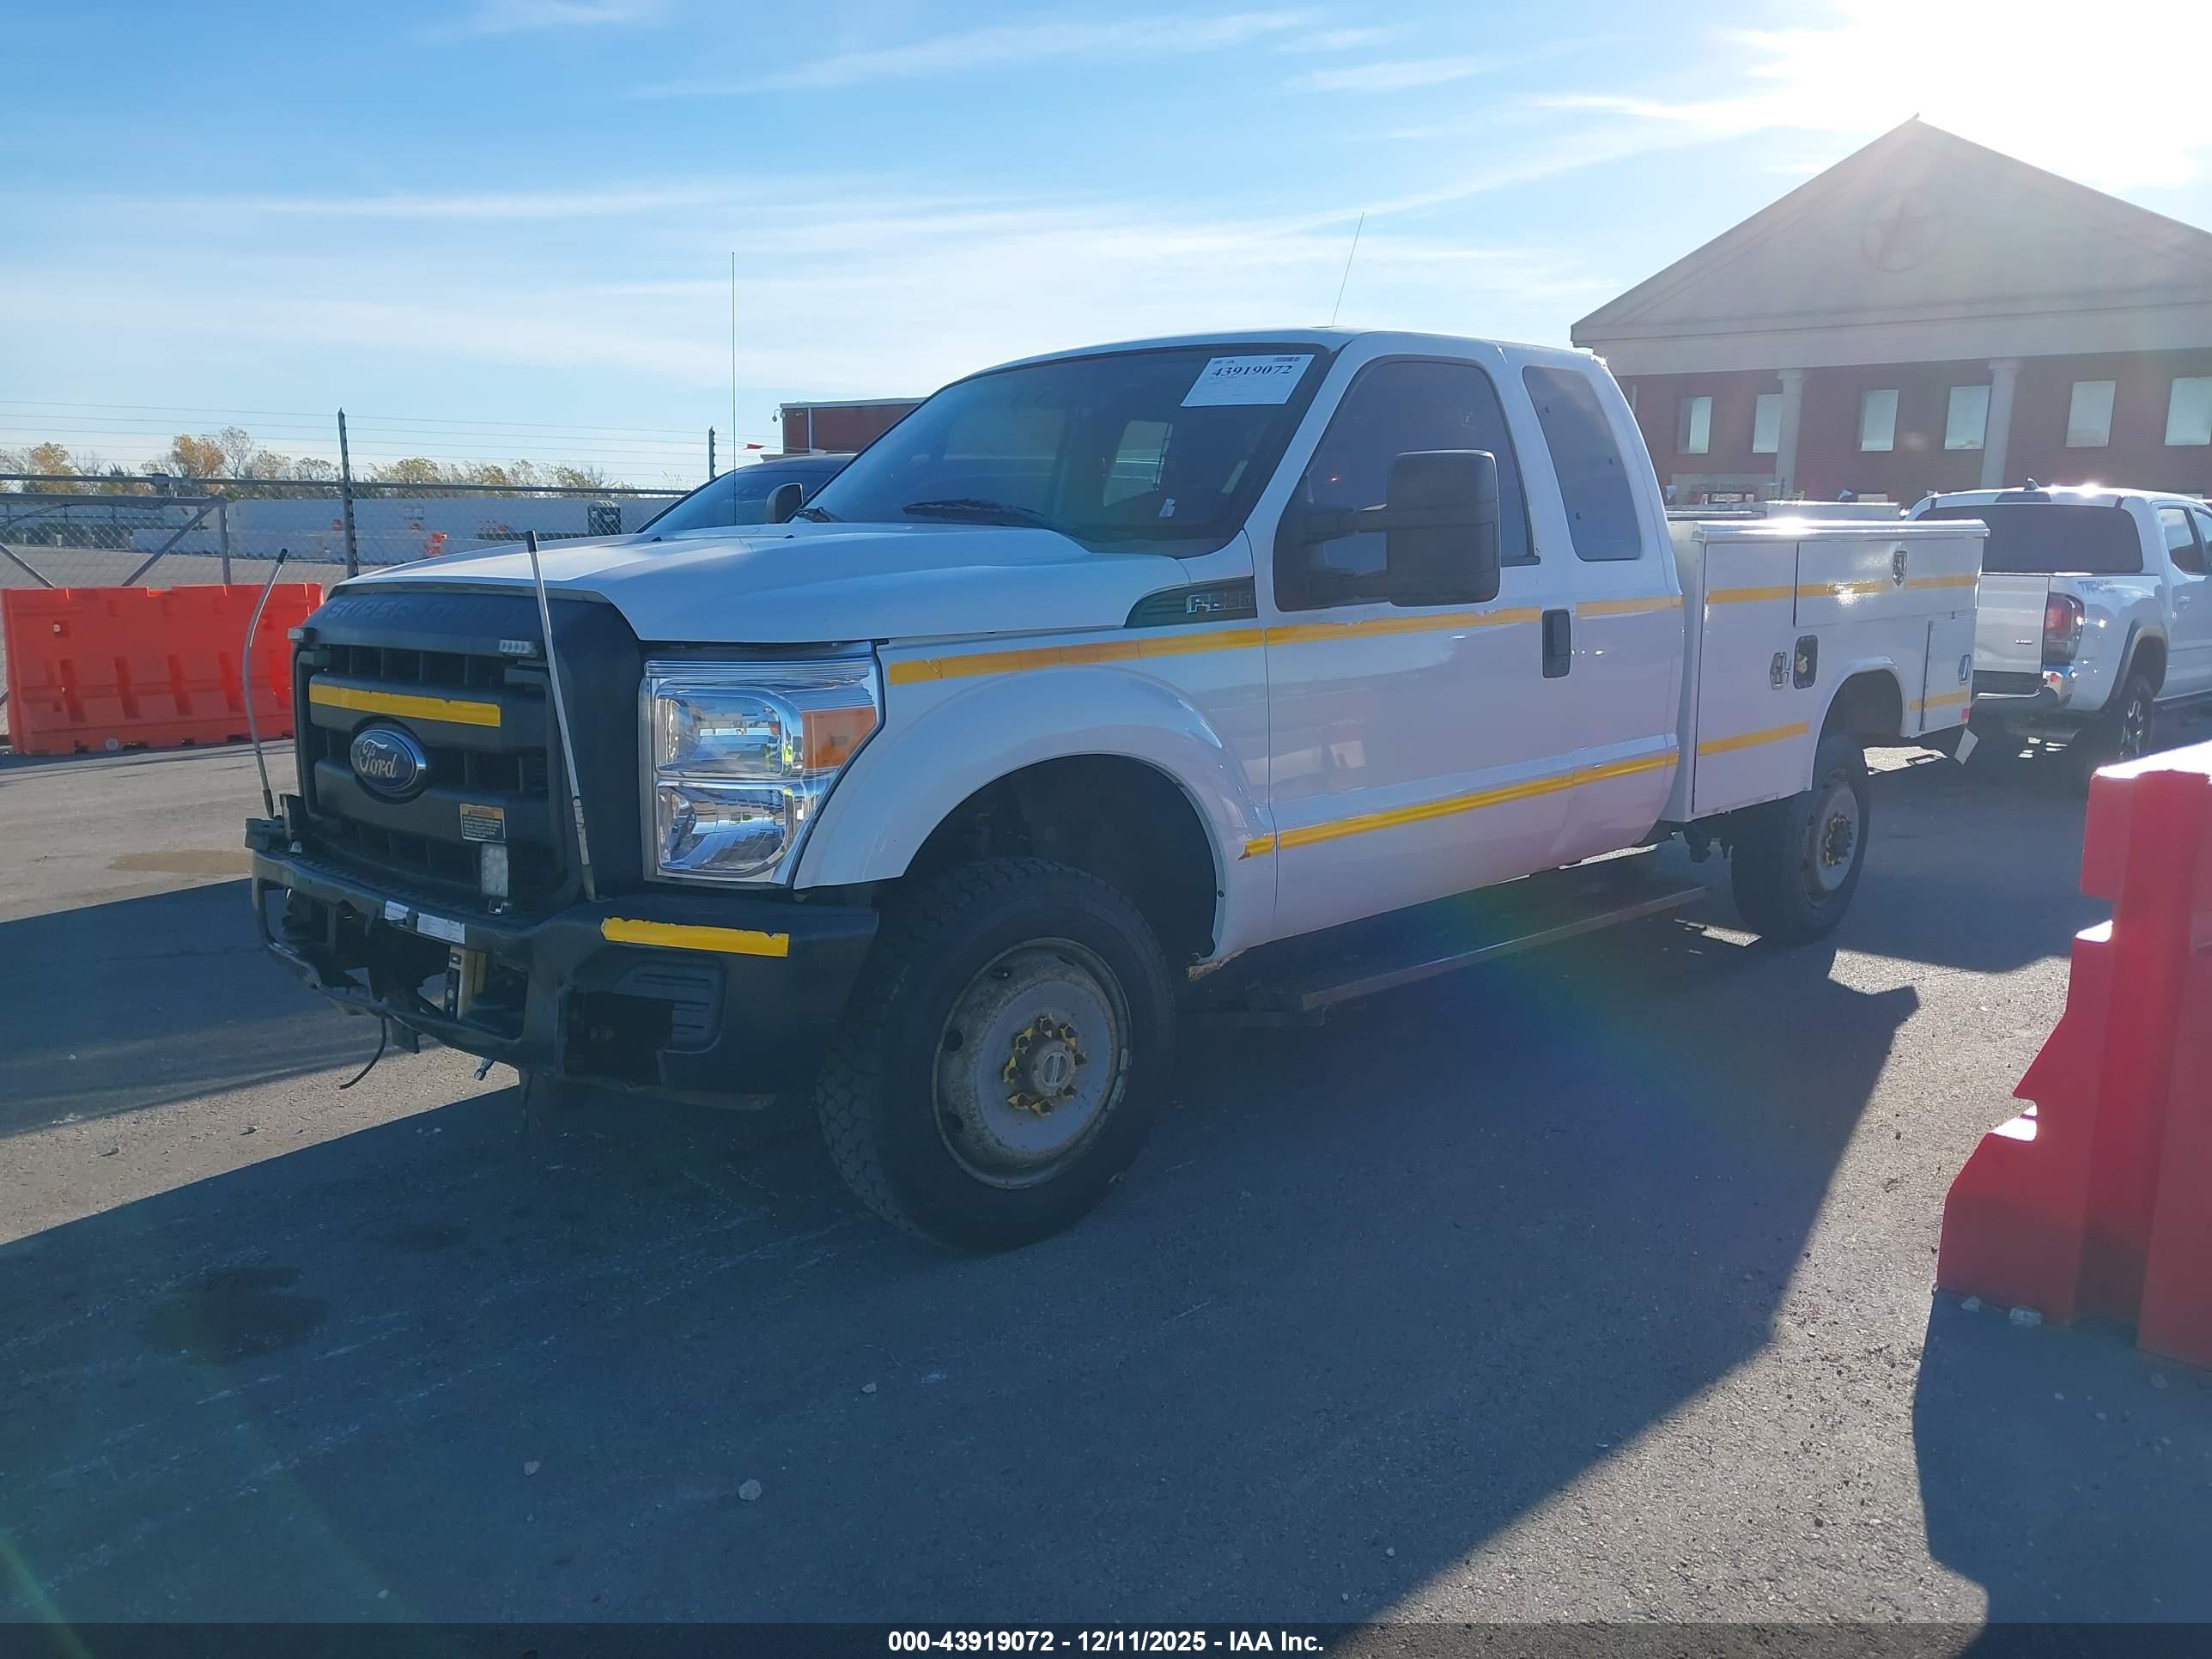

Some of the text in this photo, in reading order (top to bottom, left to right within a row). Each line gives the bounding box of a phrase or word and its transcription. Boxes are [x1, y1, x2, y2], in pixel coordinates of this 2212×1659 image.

[1211, 364, 1293, 378] 43919072
[325, 599, 414, 619] SUPER
[359, 738, 398, 779] Ford
